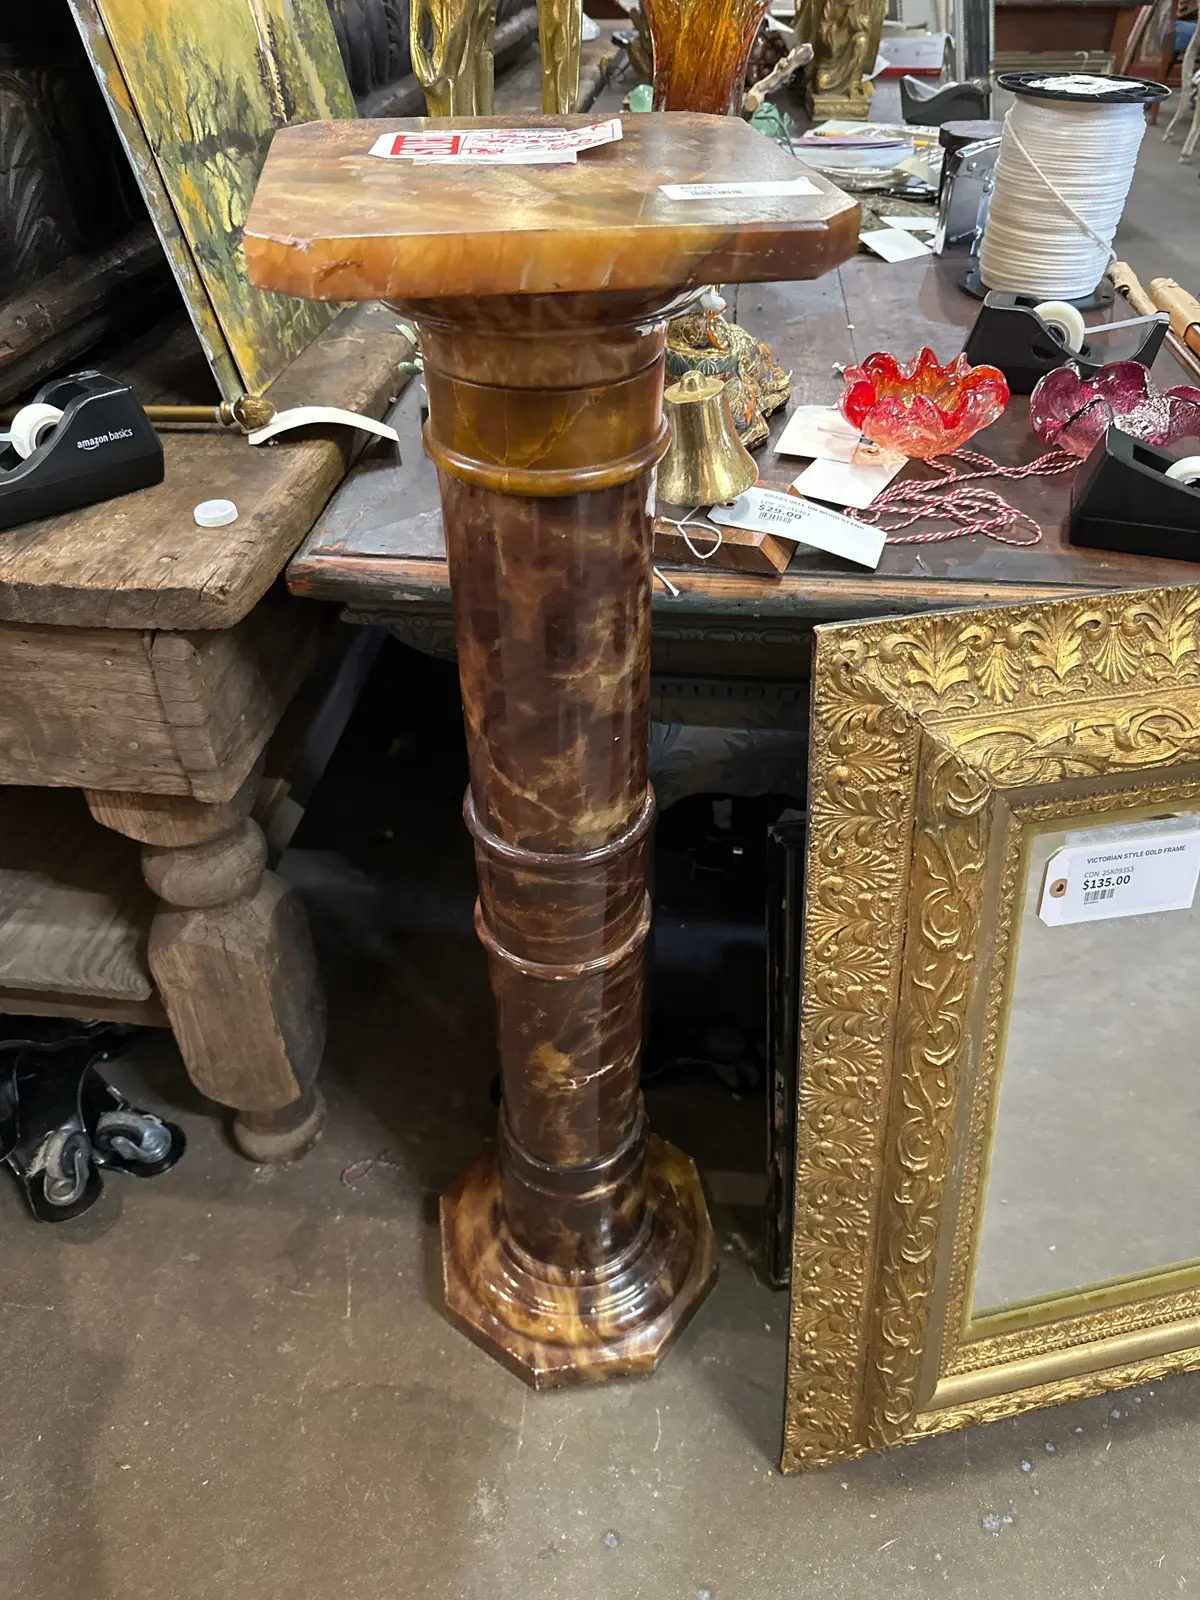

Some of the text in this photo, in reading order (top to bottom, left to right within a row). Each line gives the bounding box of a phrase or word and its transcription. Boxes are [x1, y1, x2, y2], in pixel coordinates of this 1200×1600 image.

[76, 428, 134, 451] amazon basics
[757, 504, 802, 520] $29.00
[1087, 844, 1186, 864] VICTORIAN STYLE GOLD FRAME
[1082, 874, 1131, 891] $135.00
